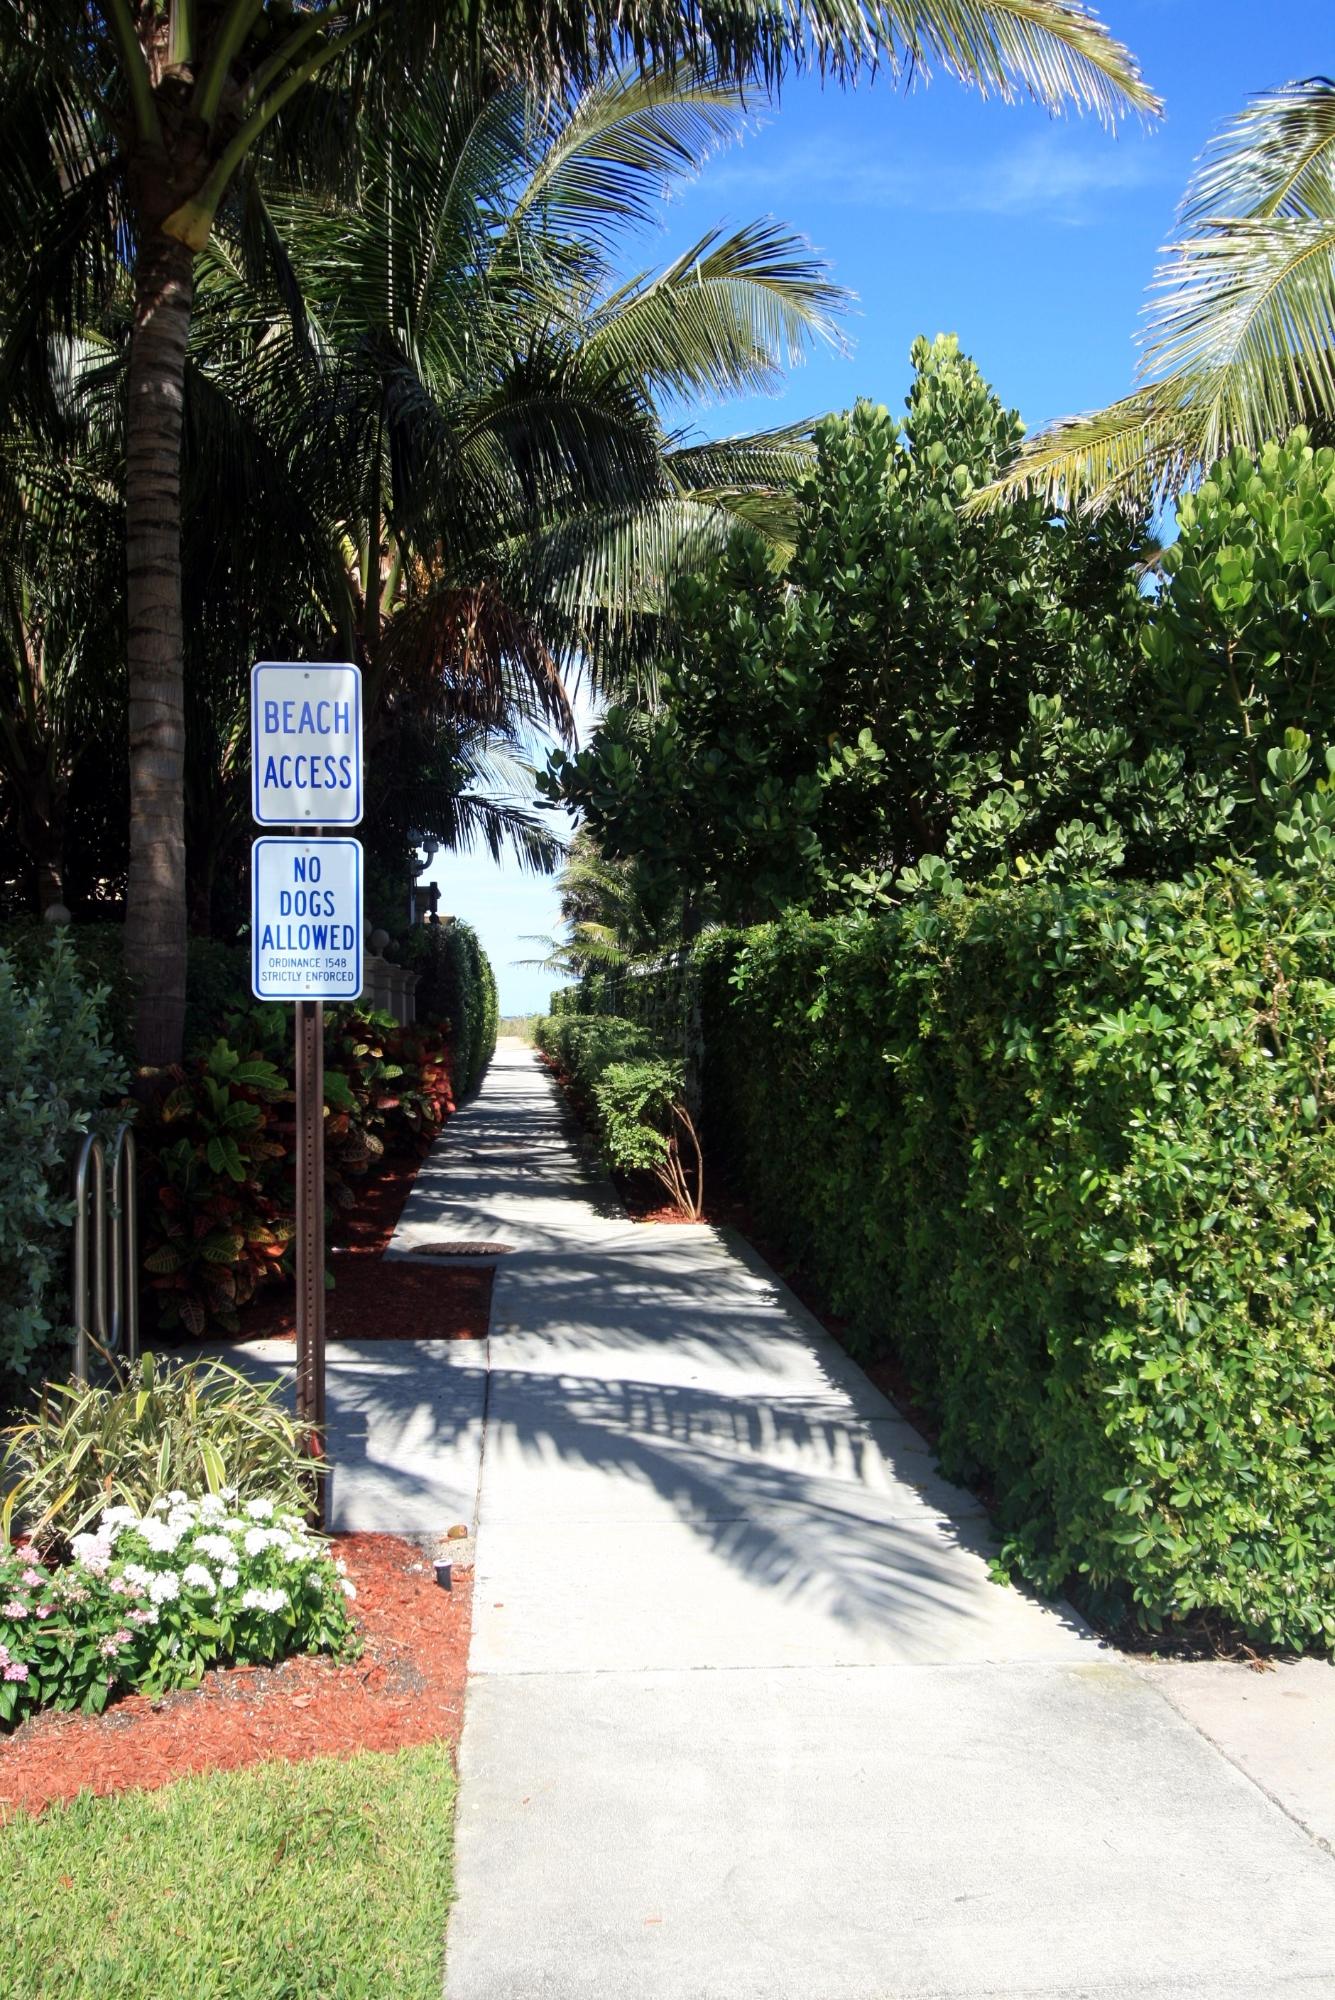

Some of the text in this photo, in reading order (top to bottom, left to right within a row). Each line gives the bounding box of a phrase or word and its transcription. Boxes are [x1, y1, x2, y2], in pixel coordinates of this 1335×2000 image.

[264, 701, 348, 734] BEACH
[264, 755, 351, 789] ACCESS
[294, 856, 321, 883] NO
[280, 890, 335, 917] DOGS
[261, 924, 354, 950] ALLOWED
[261, 971, 354, 982] STRICTLY ENFORCED
[269, 958, 347, 968] ORDINANCE 1548
